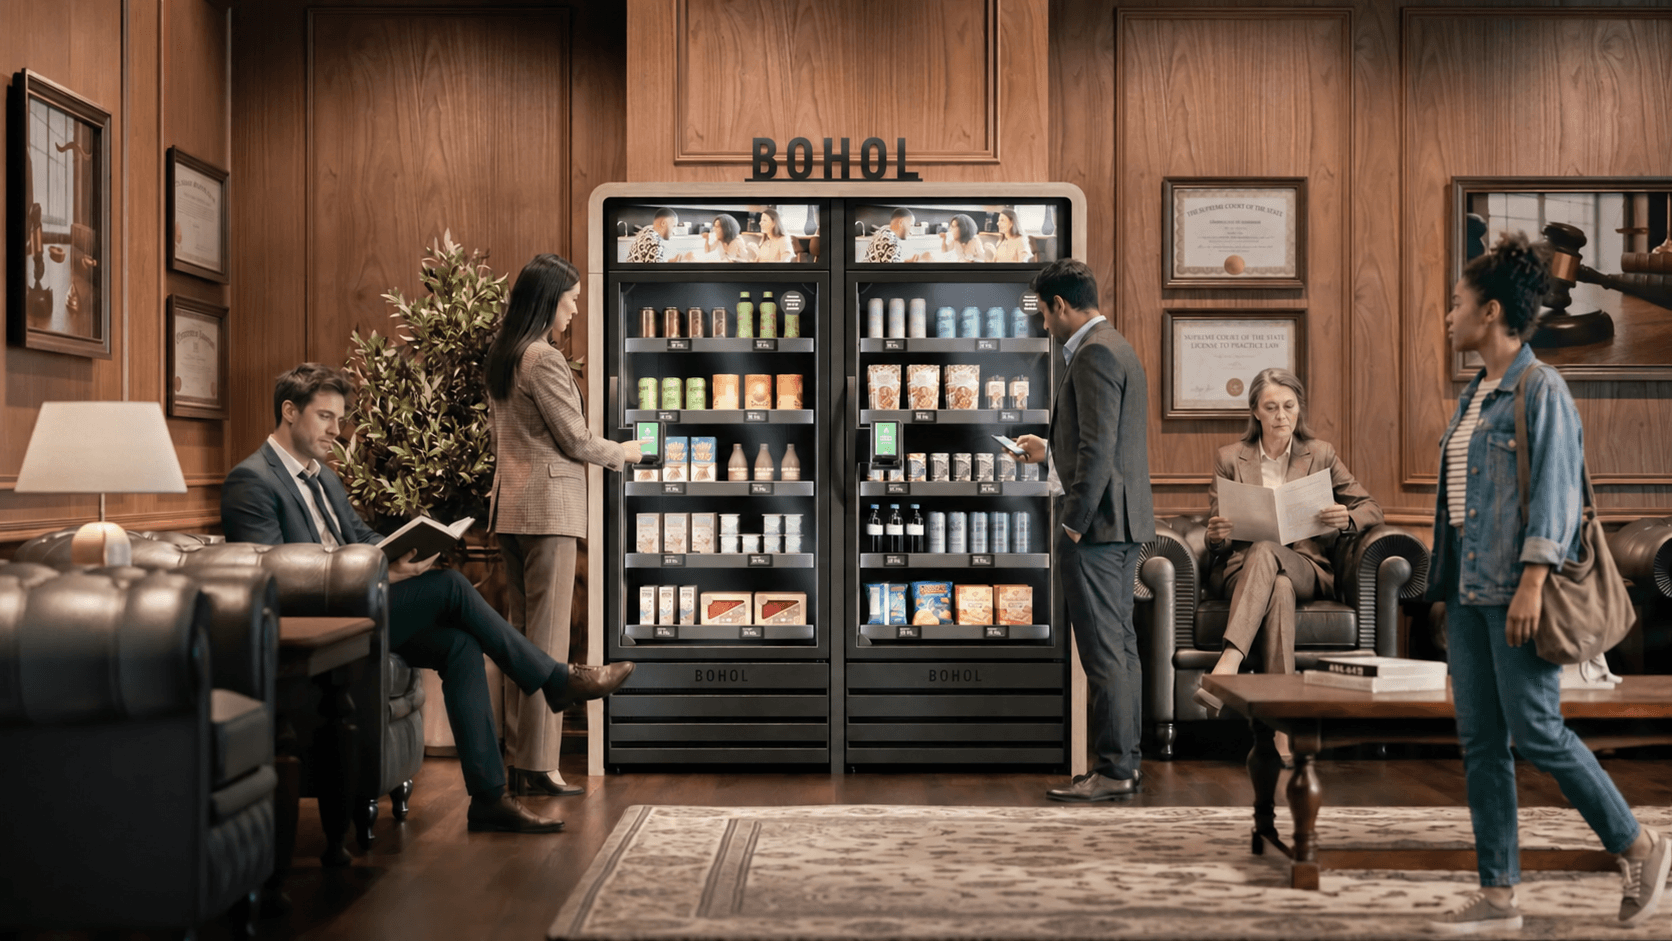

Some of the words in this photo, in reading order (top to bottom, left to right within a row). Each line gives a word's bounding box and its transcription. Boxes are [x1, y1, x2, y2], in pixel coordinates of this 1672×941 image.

[752, 137, 919, 180] BOHOL
[694, 669, 749, 682] BOHOL
[928, 669, 983, 682] BOHOL
